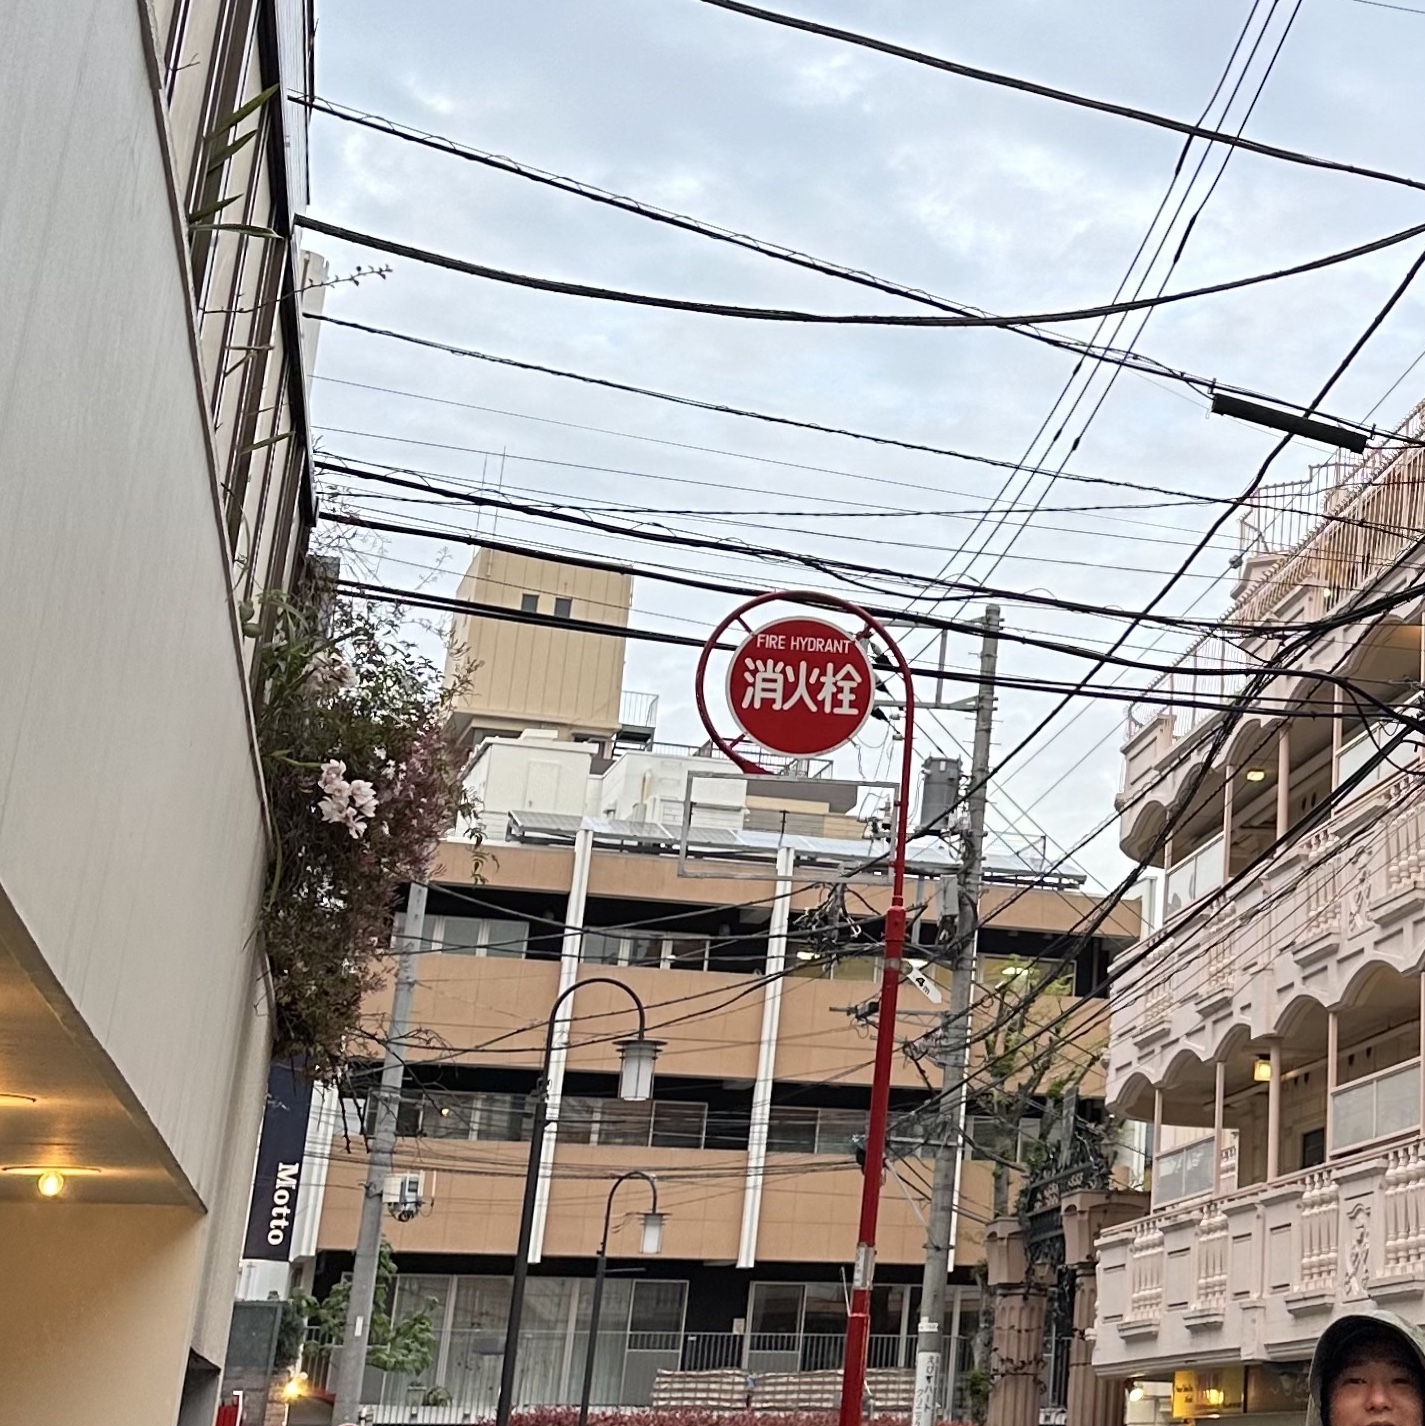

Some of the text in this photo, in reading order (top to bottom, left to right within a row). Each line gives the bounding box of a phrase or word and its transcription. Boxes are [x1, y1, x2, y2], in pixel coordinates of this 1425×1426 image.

[756, 633, 851, 654] FIRE HYDRANT
[741, 657, 862, 715] 消火栓
[267, 1162, 299, 1246] Motto
